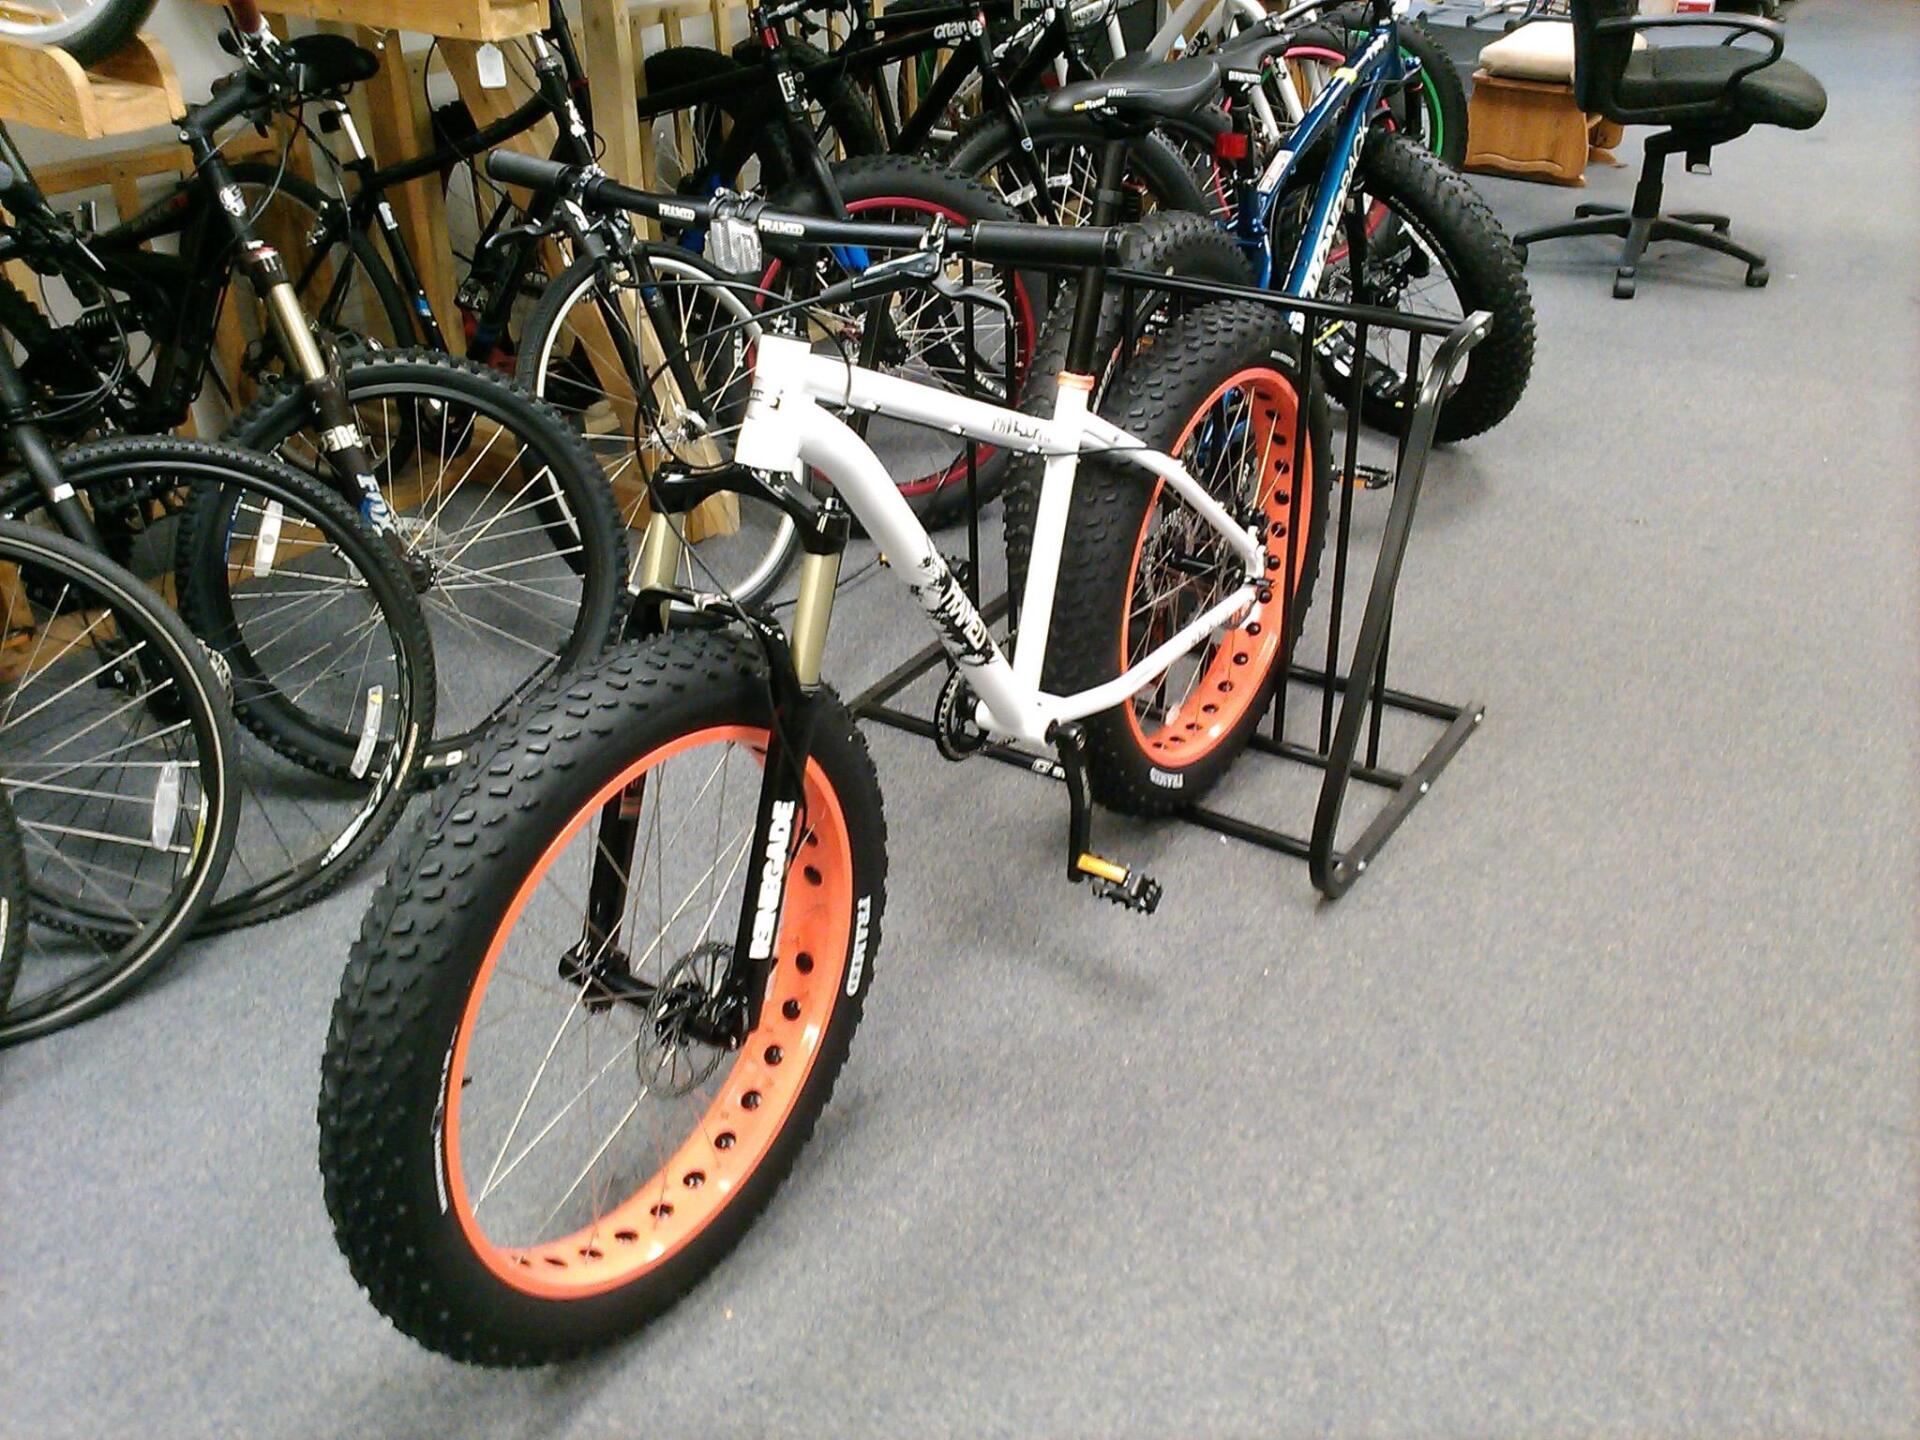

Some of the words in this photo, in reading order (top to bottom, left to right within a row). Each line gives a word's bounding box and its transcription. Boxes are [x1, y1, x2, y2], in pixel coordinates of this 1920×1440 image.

[658, 203, 695, 222] FRAMED
[758, 218, 805, 237] FRAMED
[749, 800, 796, 960] RENEGADE
